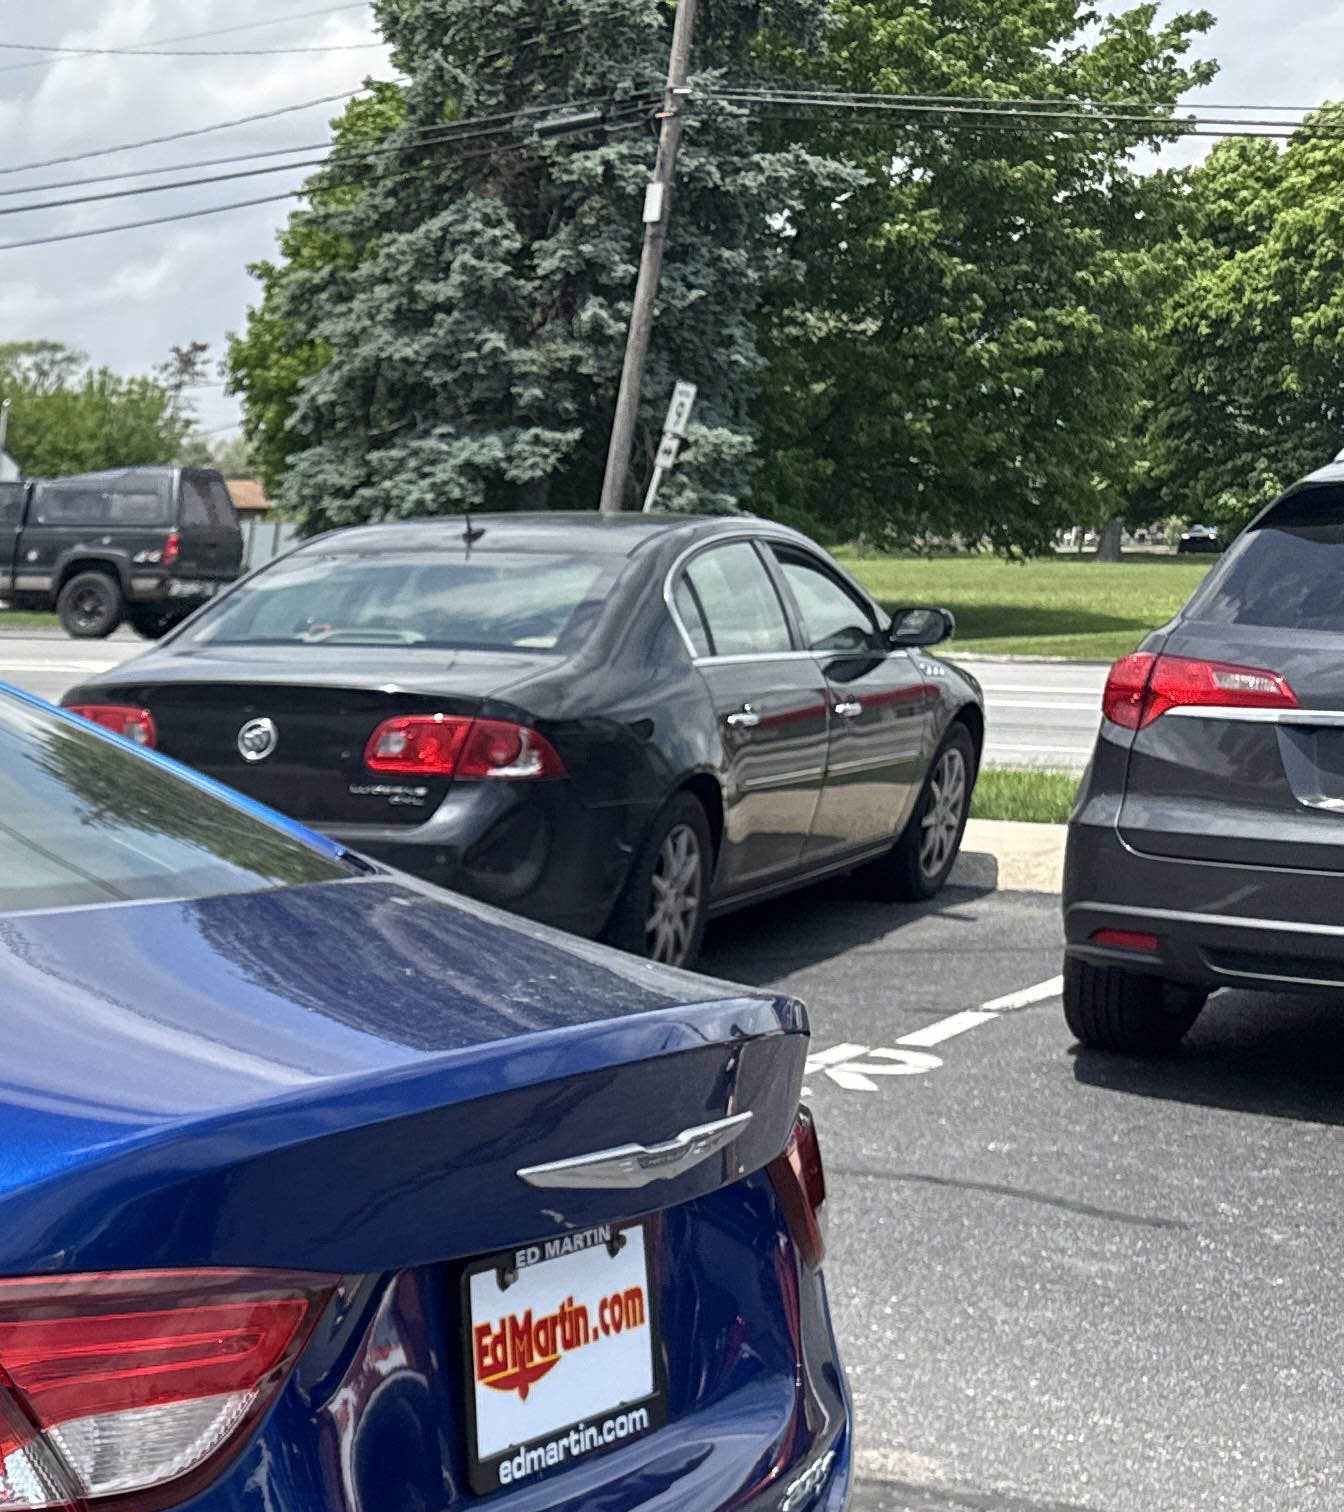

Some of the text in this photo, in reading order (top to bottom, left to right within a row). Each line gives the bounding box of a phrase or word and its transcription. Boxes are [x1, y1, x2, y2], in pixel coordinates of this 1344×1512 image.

[515, 1224, 611, 1268] ED MARTIN
[474, 1286, 645, 1383] EdMartin.com
[499, 1407, 649, 1485] edmartin.com
